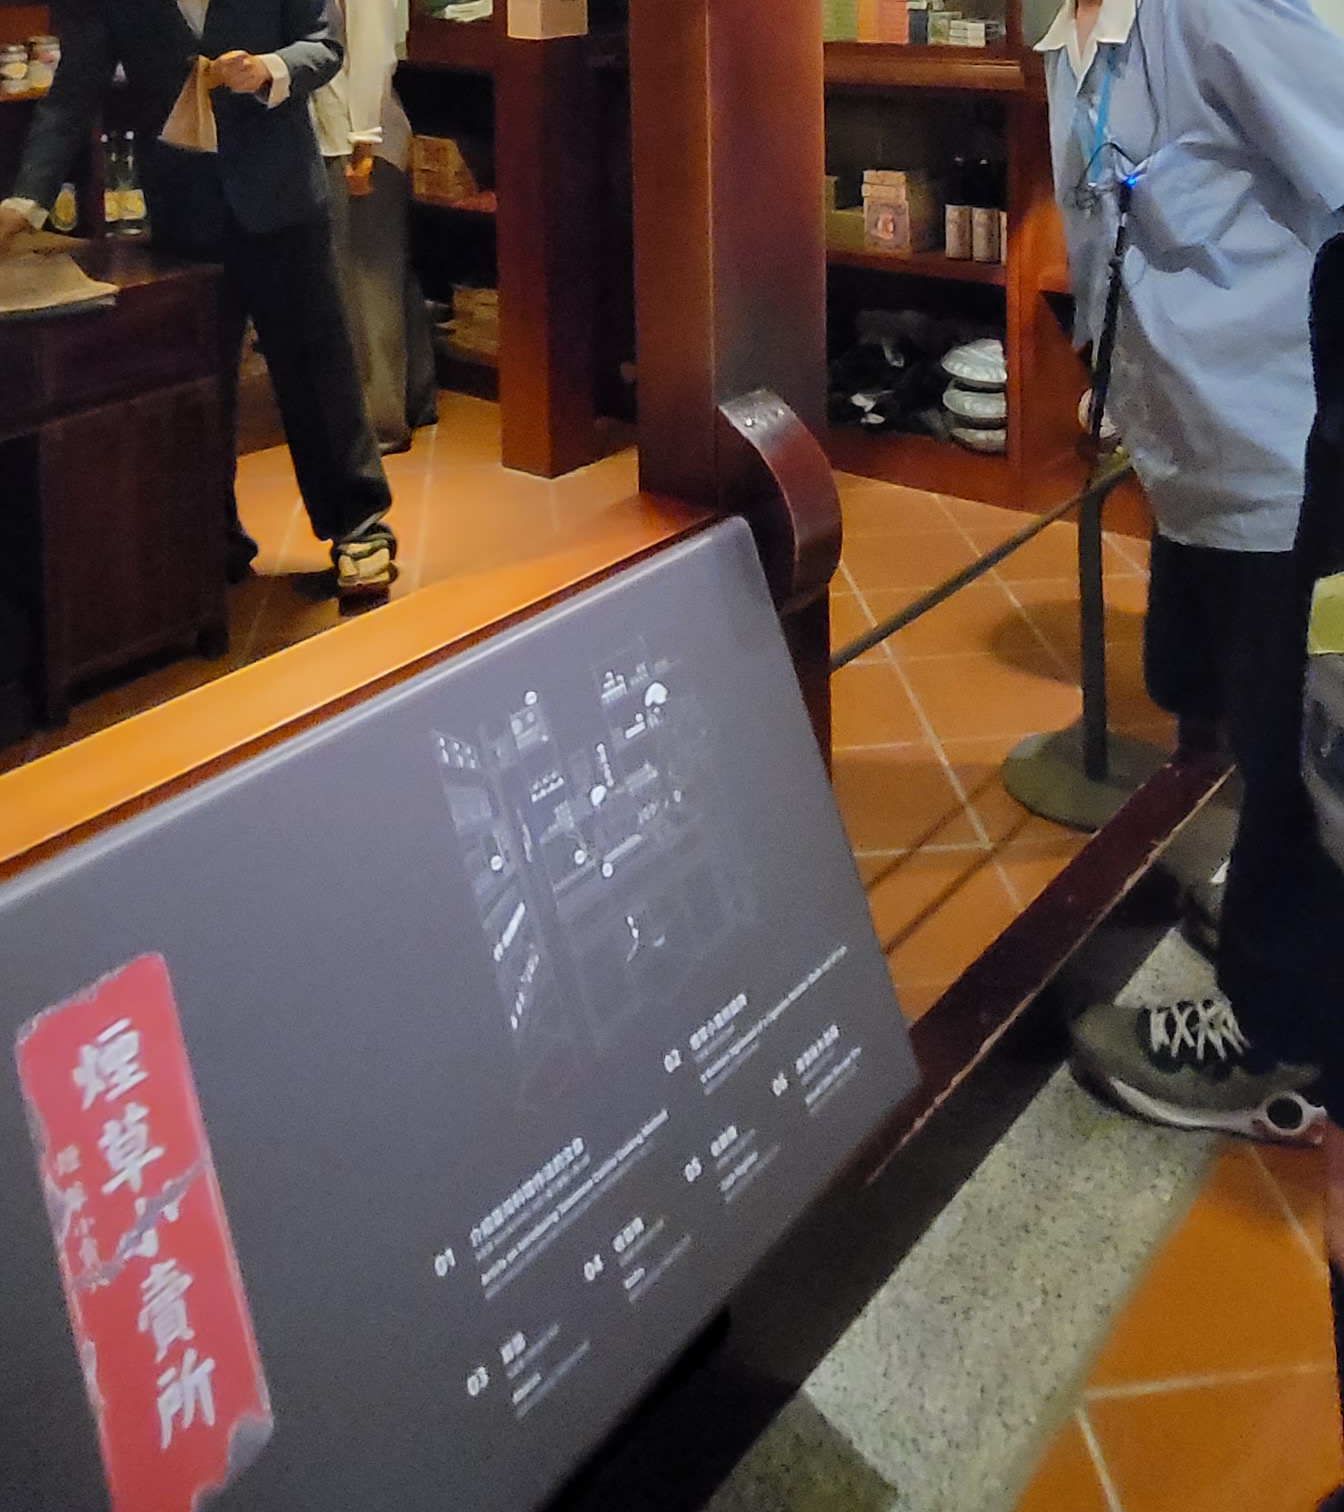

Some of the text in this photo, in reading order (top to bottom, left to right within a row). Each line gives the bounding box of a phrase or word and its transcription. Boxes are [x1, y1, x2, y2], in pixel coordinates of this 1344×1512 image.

[72, 1016, 217, 1451] 煙草小賣所
[434, 1247, 457, 1277] 01
